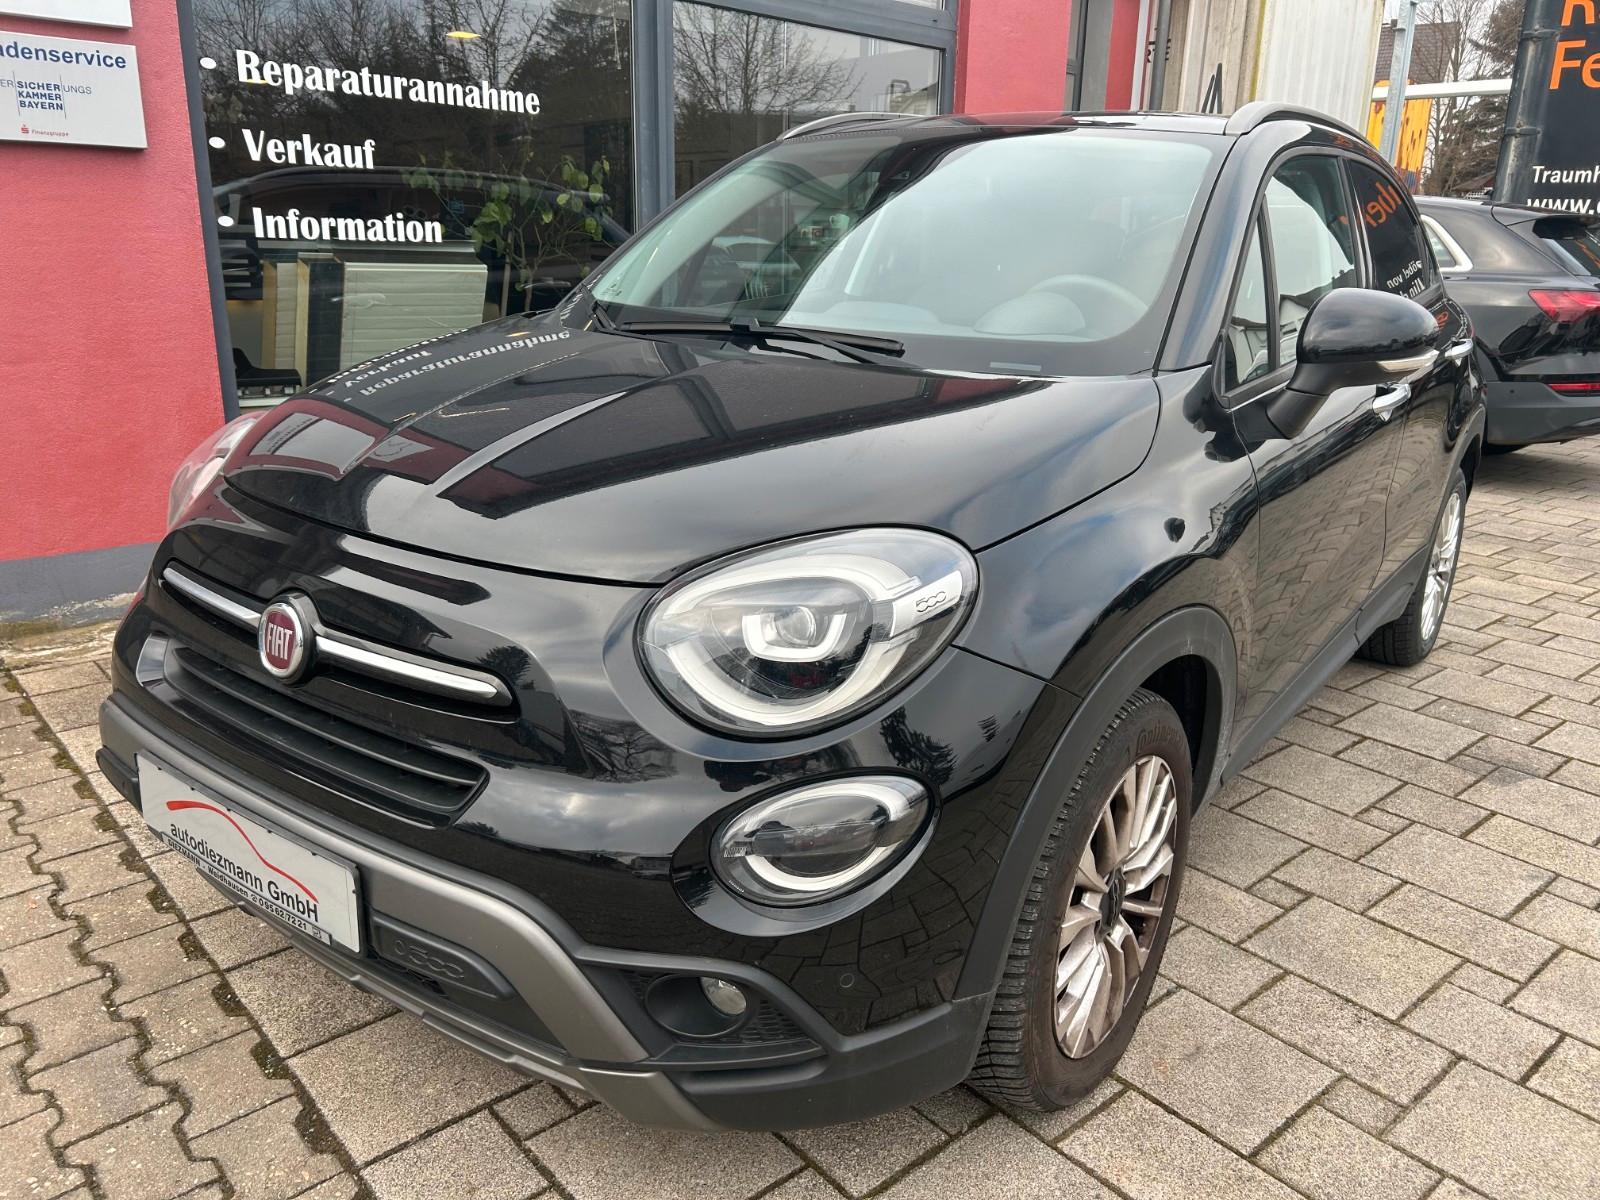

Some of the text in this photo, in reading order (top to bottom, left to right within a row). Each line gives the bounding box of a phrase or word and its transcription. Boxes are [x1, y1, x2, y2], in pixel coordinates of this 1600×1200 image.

[17, 80, 60, 91] SICHER
[63, 84, 92, 95] UNGS
[18, 90, 62, 102] KAMMER
[236, 49, 541, 115] Reparaturannahme
[20, 100, 64, 111] BAYERN
[242, 129, 377, 170] Verkauf
[1527, 198, 1600, 216] www.
[252, 207, 444, 243] Information
[915, 590, 947, 613] 500
[265, 622, 294, 661] FIAT
[169, 821, 319, 923] autodiezmann GmbH
[207, 865, 249, 898] Weidhausen
